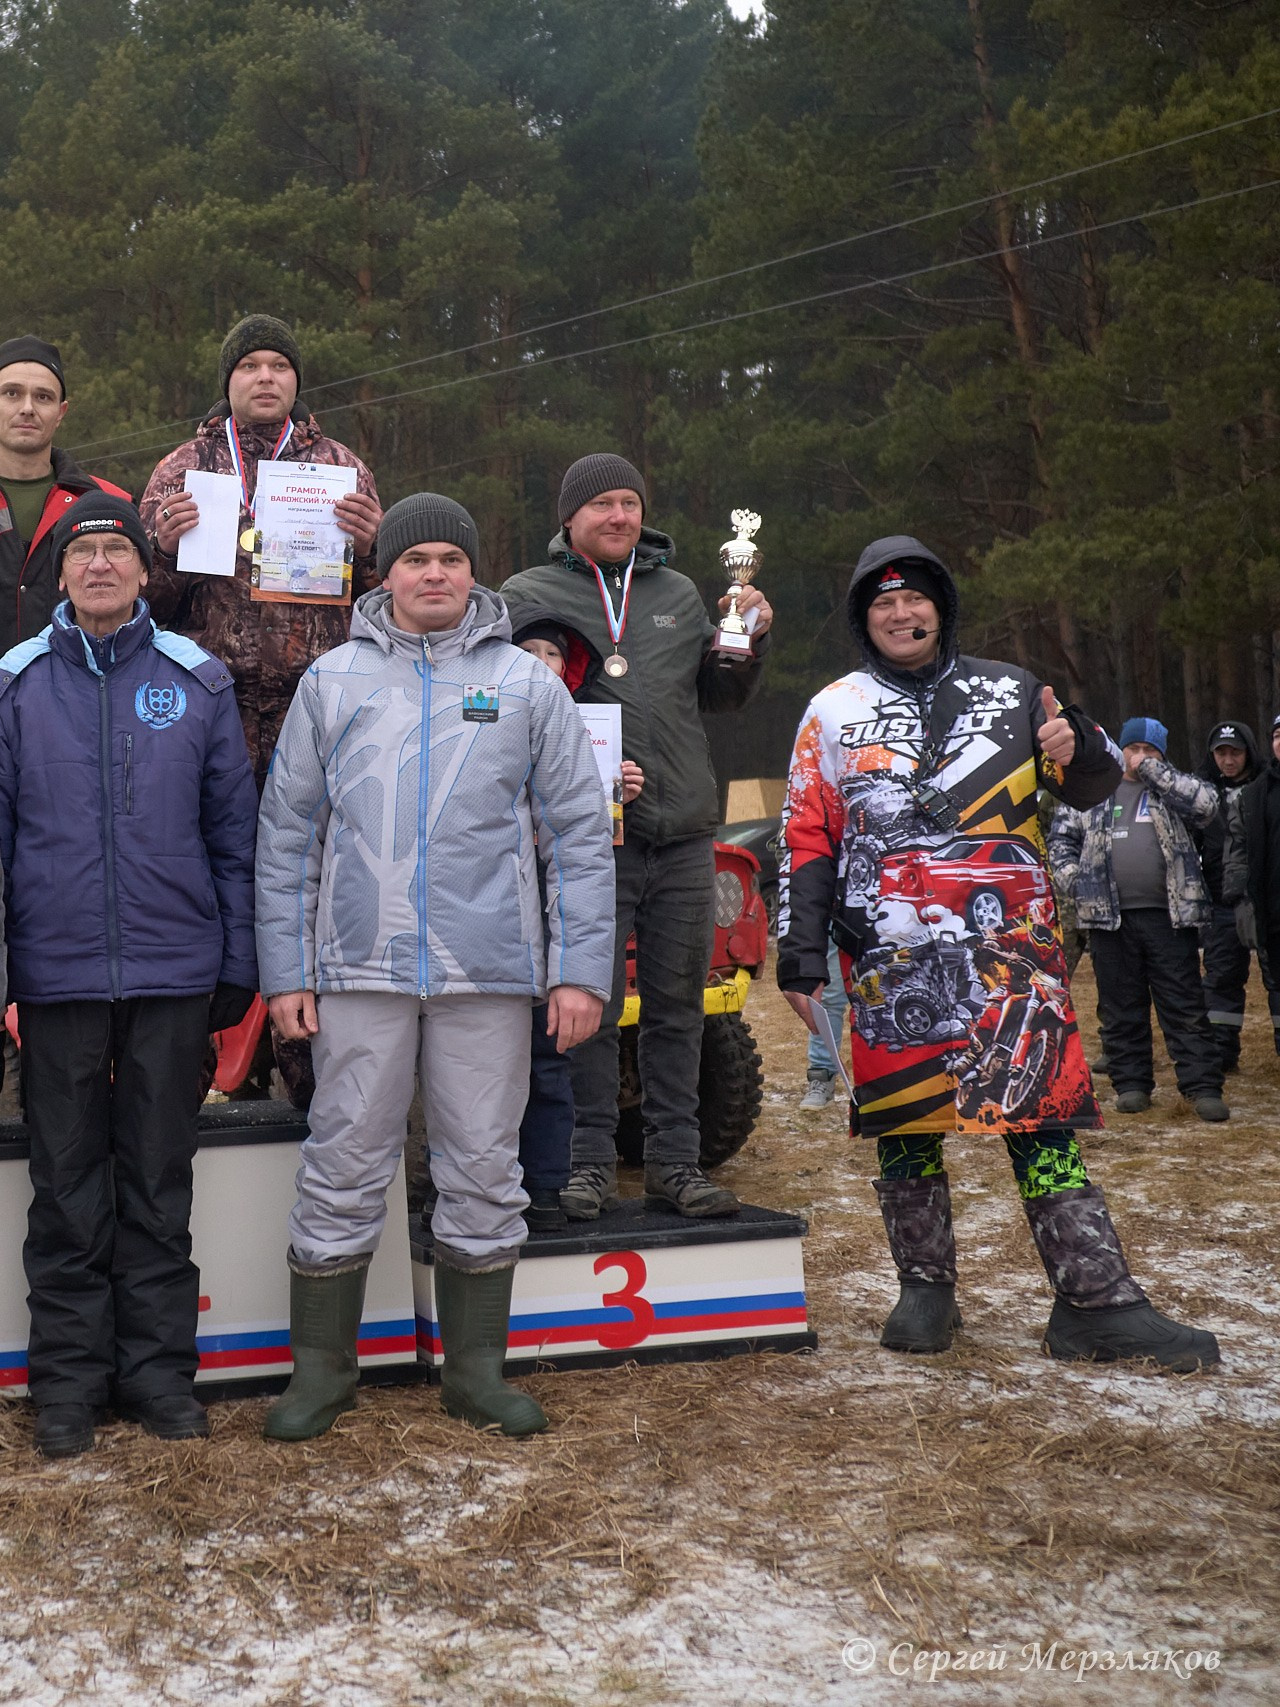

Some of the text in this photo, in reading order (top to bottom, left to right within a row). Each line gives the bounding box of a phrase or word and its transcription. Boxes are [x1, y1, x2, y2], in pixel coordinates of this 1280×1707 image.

[270, 495, 320, 504] ВАВОЖСКИЙ
[285, 486, 327, 495] ГРАМОТА
[1032, 868, 1047, 895] 9
[593, 1250, 655, 1350] 3
